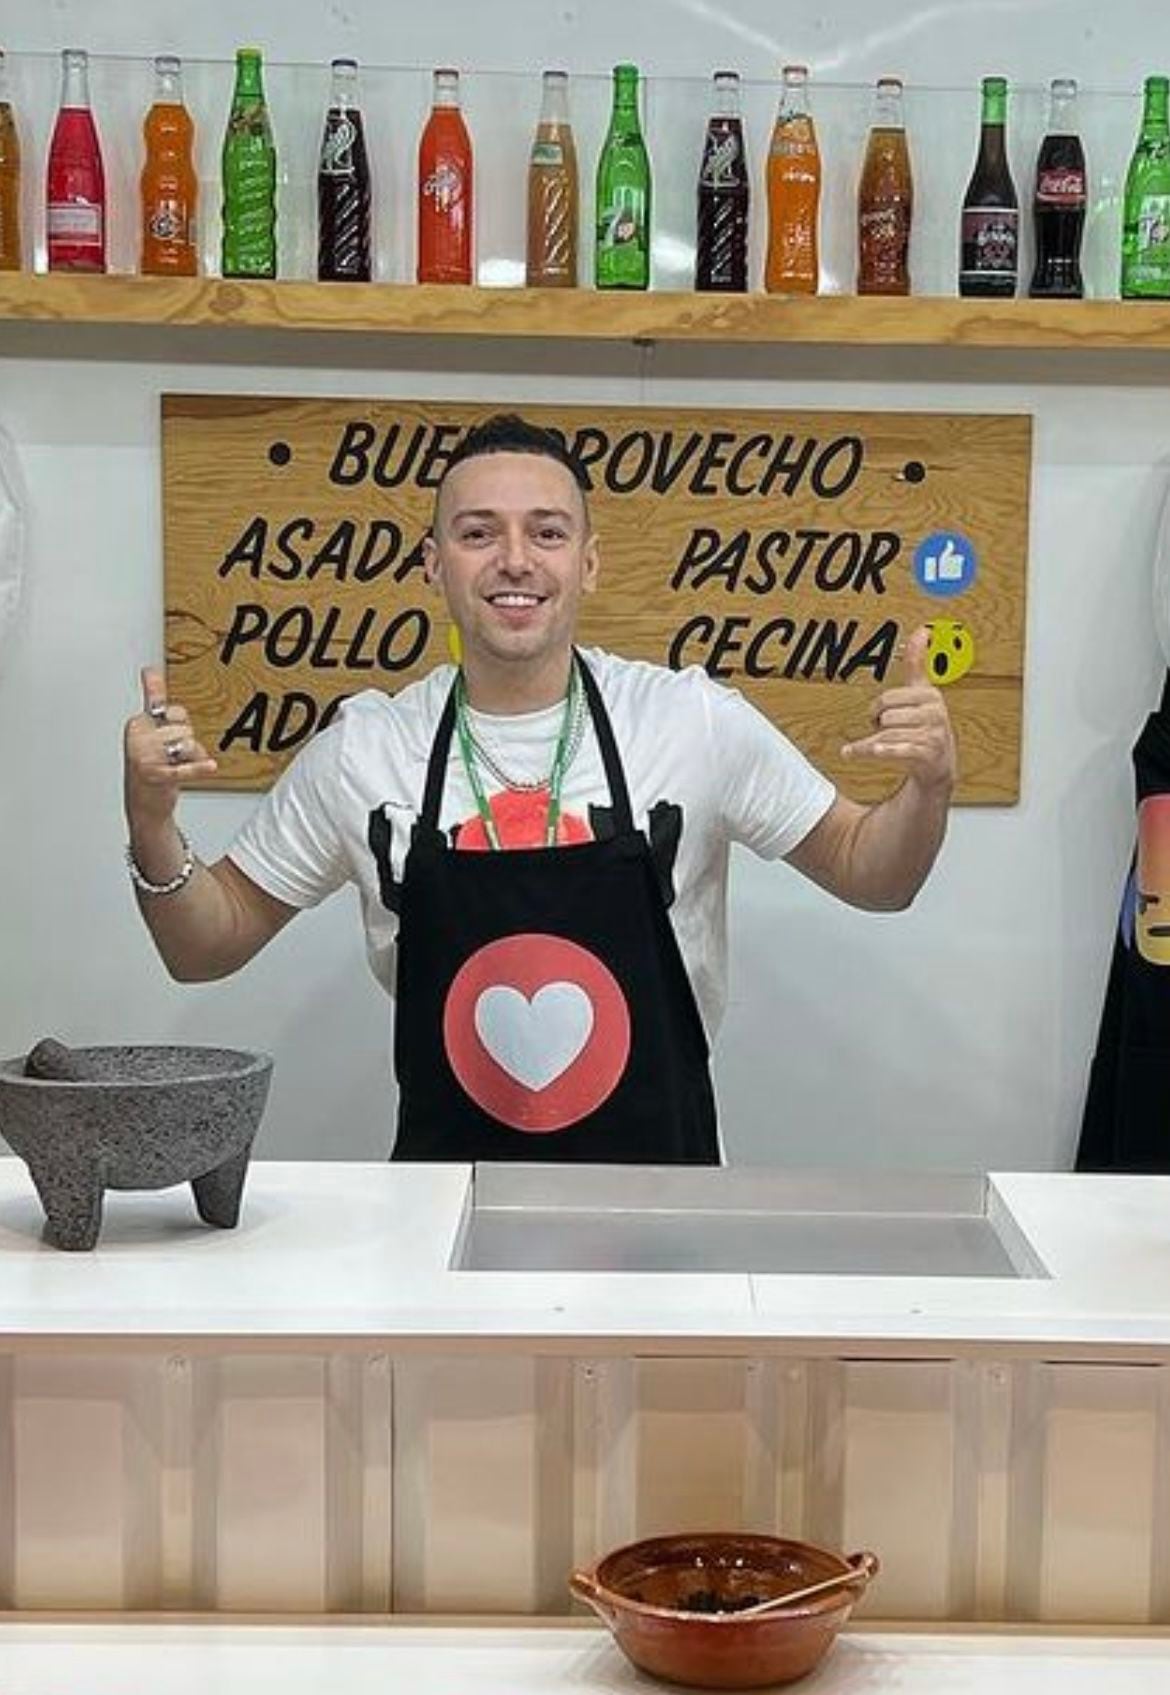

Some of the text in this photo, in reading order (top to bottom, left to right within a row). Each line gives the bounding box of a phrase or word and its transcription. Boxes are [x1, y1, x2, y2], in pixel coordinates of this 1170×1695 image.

[218, 517, 434, 584] ASADA
[670, 528, 901, 595] PASTOR
[219, 604, 430, 671] POLLO
[668, 615, 898, 682] CECINA
